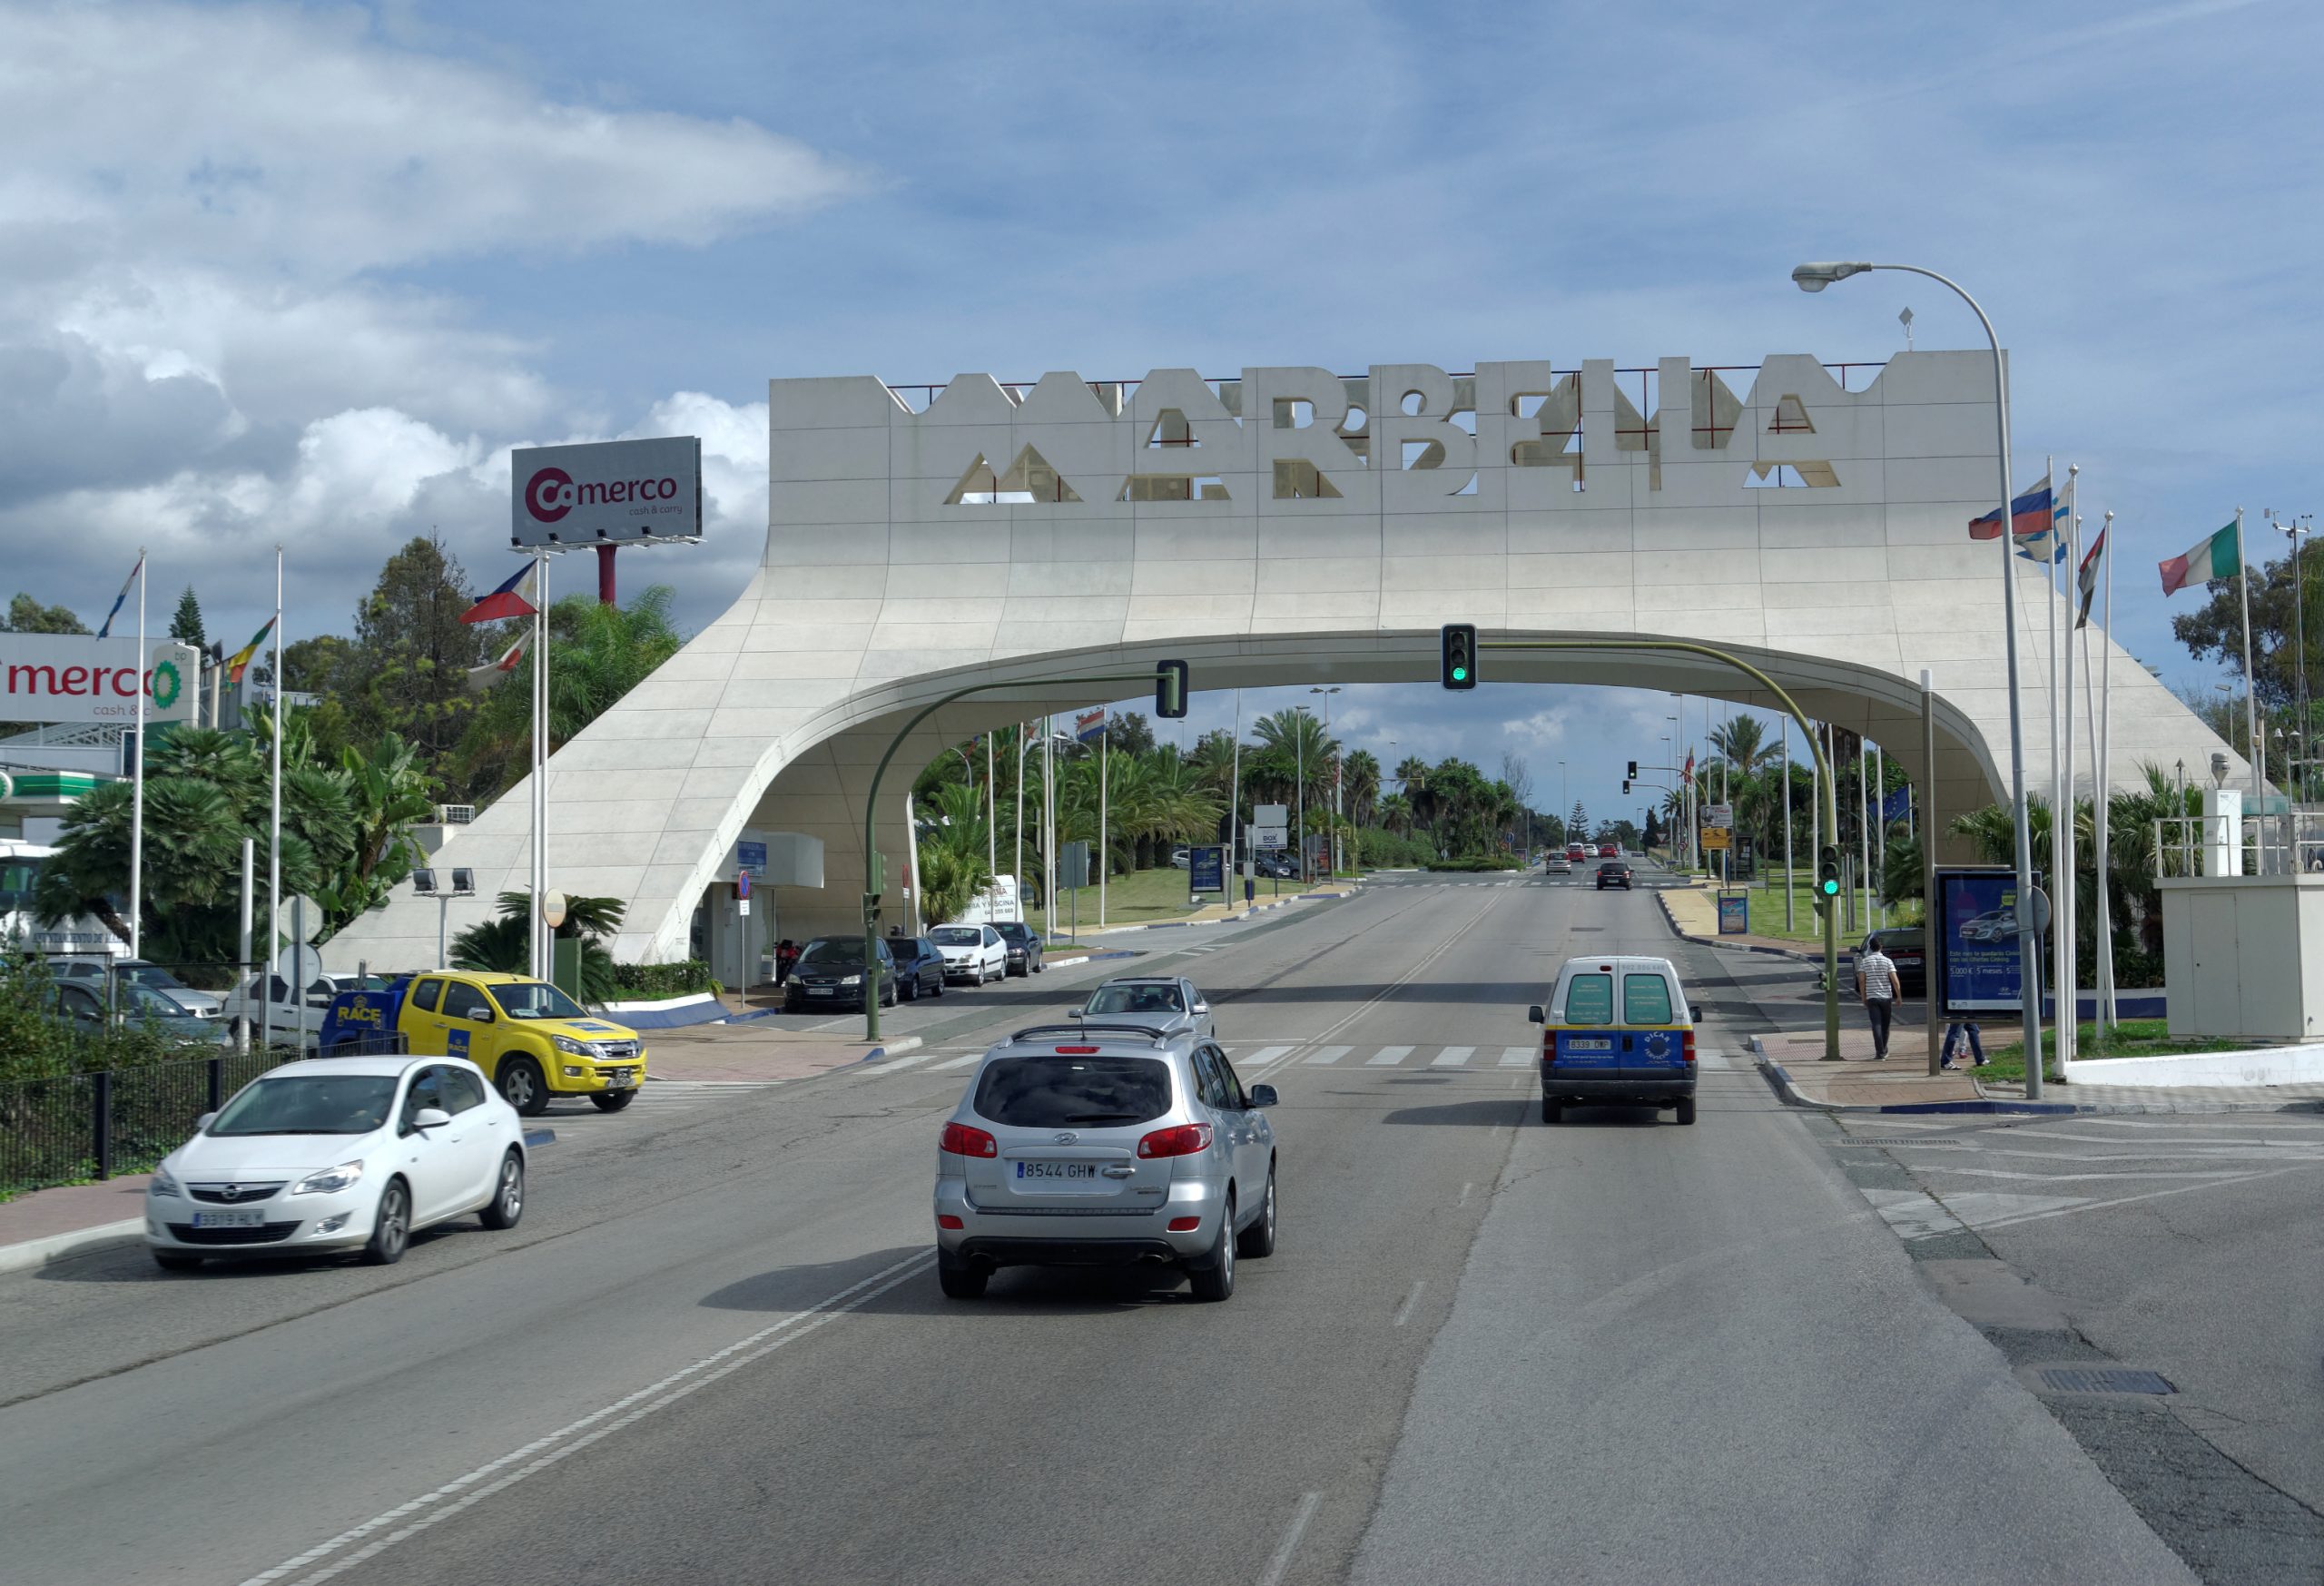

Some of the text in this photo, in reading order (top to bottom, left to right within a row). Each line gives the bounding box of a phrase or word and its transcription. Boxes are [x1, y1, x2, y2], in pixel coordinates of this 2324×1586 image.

[919, 352, 1863, 506] MARBELLA
[629, 506, 682, 516] cash & carry
[174, 652, 187, 661] bp
[94, 704, 125, 716] cash
[338, 1007, 381, 1021] RACE
[1644, 1031, 1670, 1043] DICAR
[448, 1044, 468, 1052] RACE
[1026, 1163, 1095, 1177] 8544 GHW
